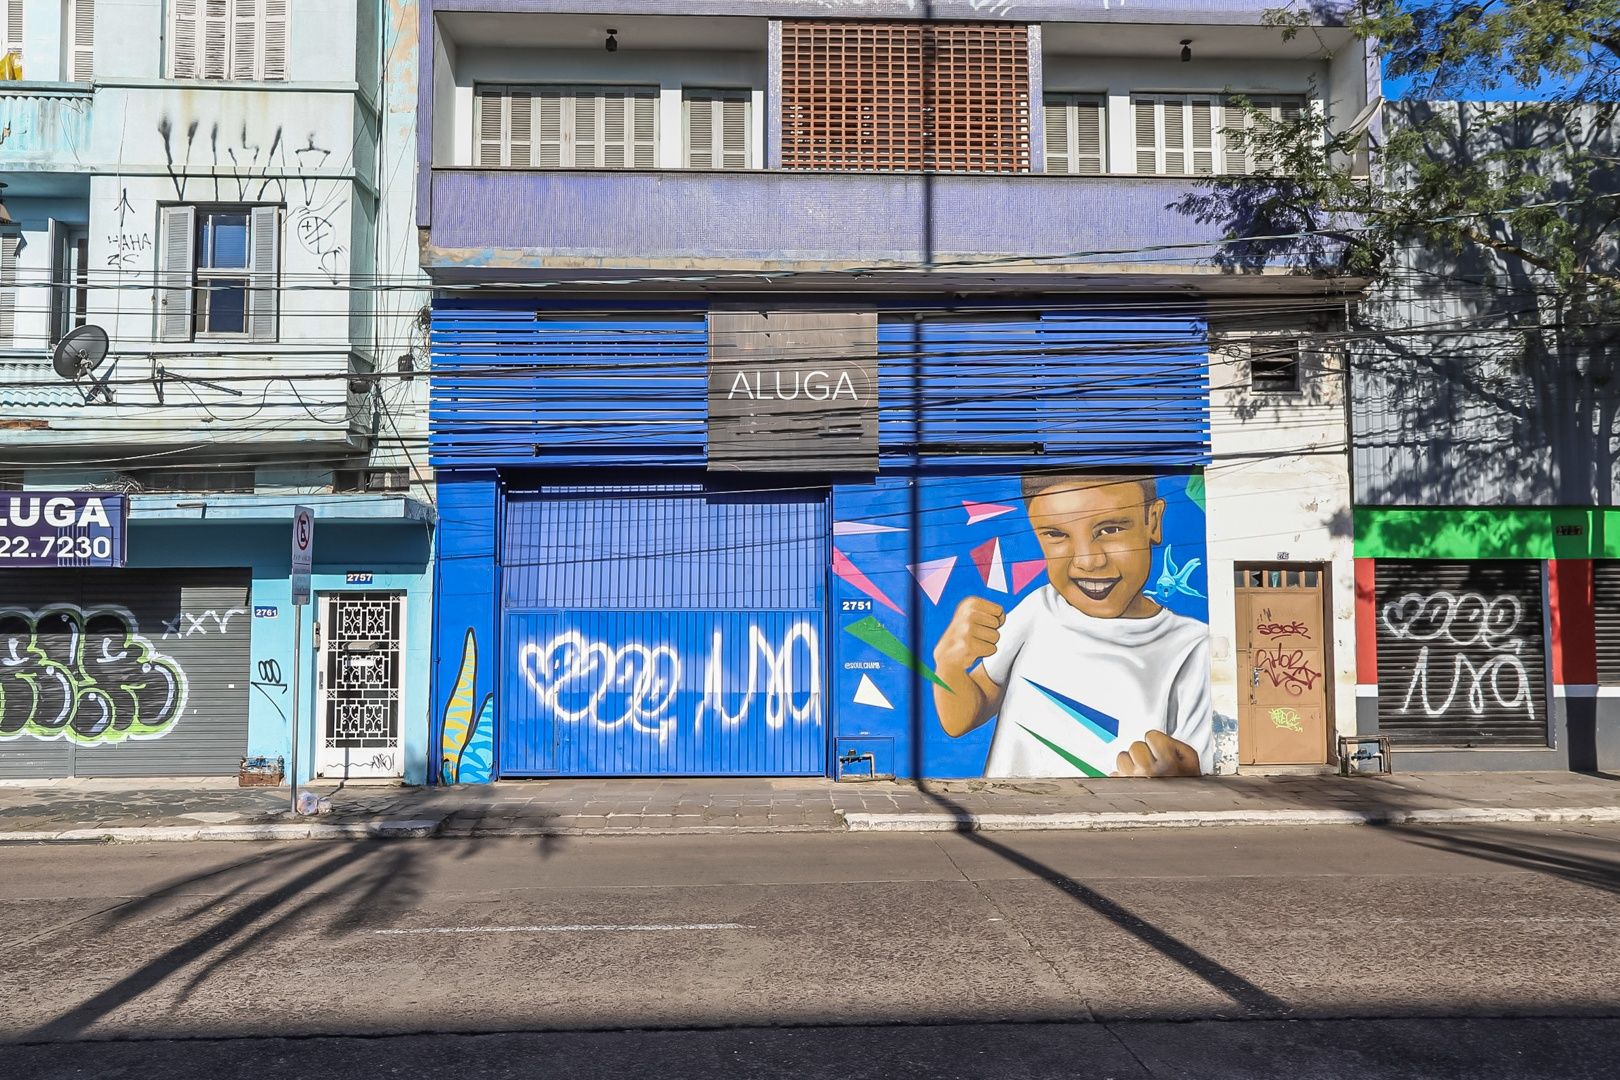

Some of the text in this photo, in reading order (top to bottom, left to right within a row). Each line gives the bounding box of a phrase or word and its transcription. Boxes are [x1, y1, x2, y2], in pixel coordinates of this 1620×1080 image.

[727, 370, 858, 401] ALUGA
[0, 497, 111, 527] UGA
[0, 536, 111, 558] 22.7230
[347, 573, 372, 582] 2757
[255, 608, 278, 617] 2761
[842, 601, 872, 611] 2751
